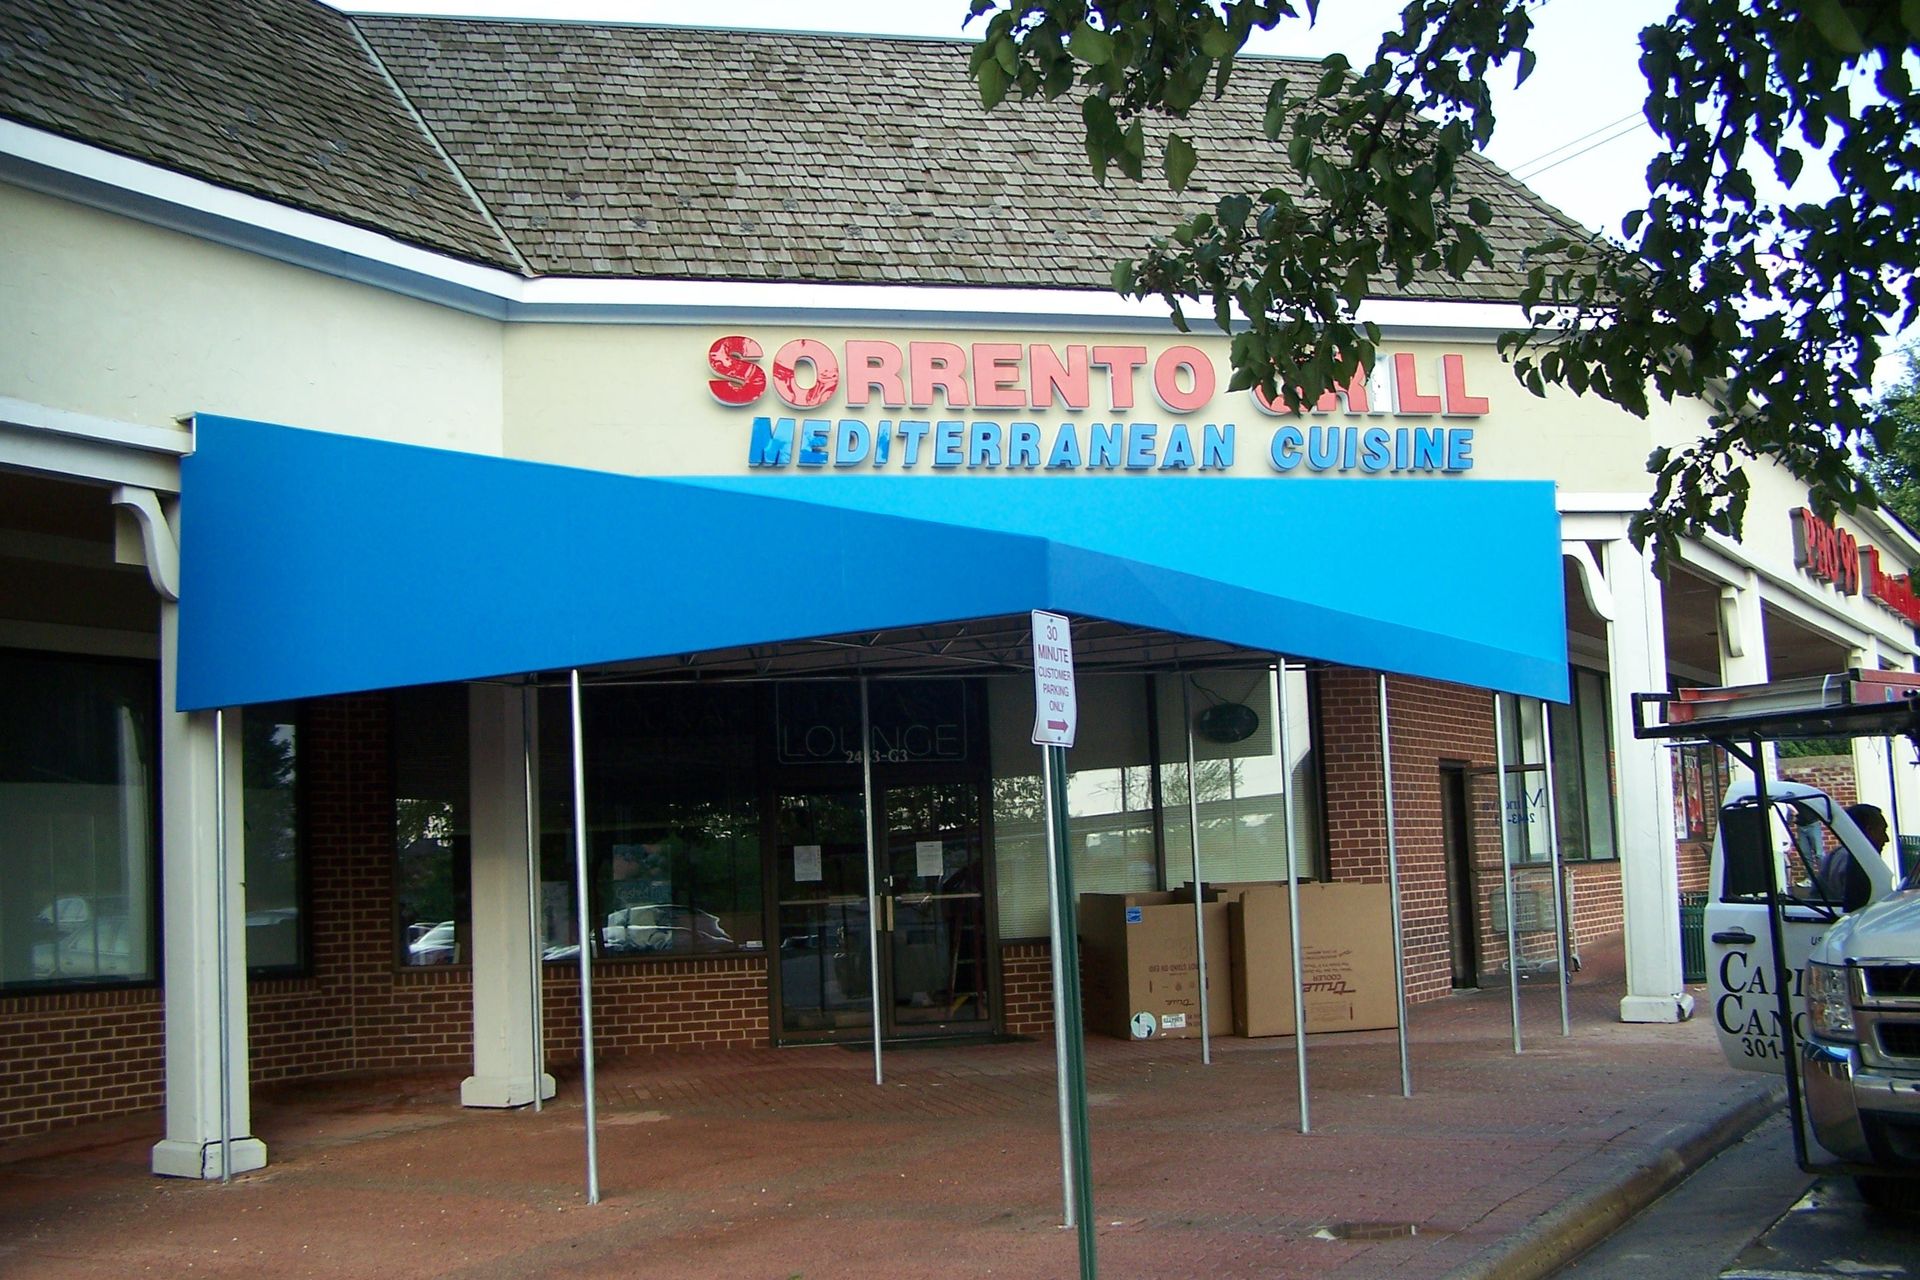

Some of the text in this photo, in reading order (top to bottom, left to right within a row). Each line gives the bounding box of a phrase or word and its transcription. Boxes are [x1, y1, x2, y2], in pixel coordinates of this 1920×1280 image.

[707, 335, 1215, 413] SORRENTO
[748, 416, 1474, 473] MEDITERRANEAN CUISINE
[1046, 625, 1058, 641] 30
[1037, 643, 1070, 664] MINUTE
[1038, 666, 1071, 681] CUSTOMER
[1042, 683, 1070, 697] PARKING
[1049, 700, 1065, 712] ONLY
[1313, 973, 1342, 982] COOLER
